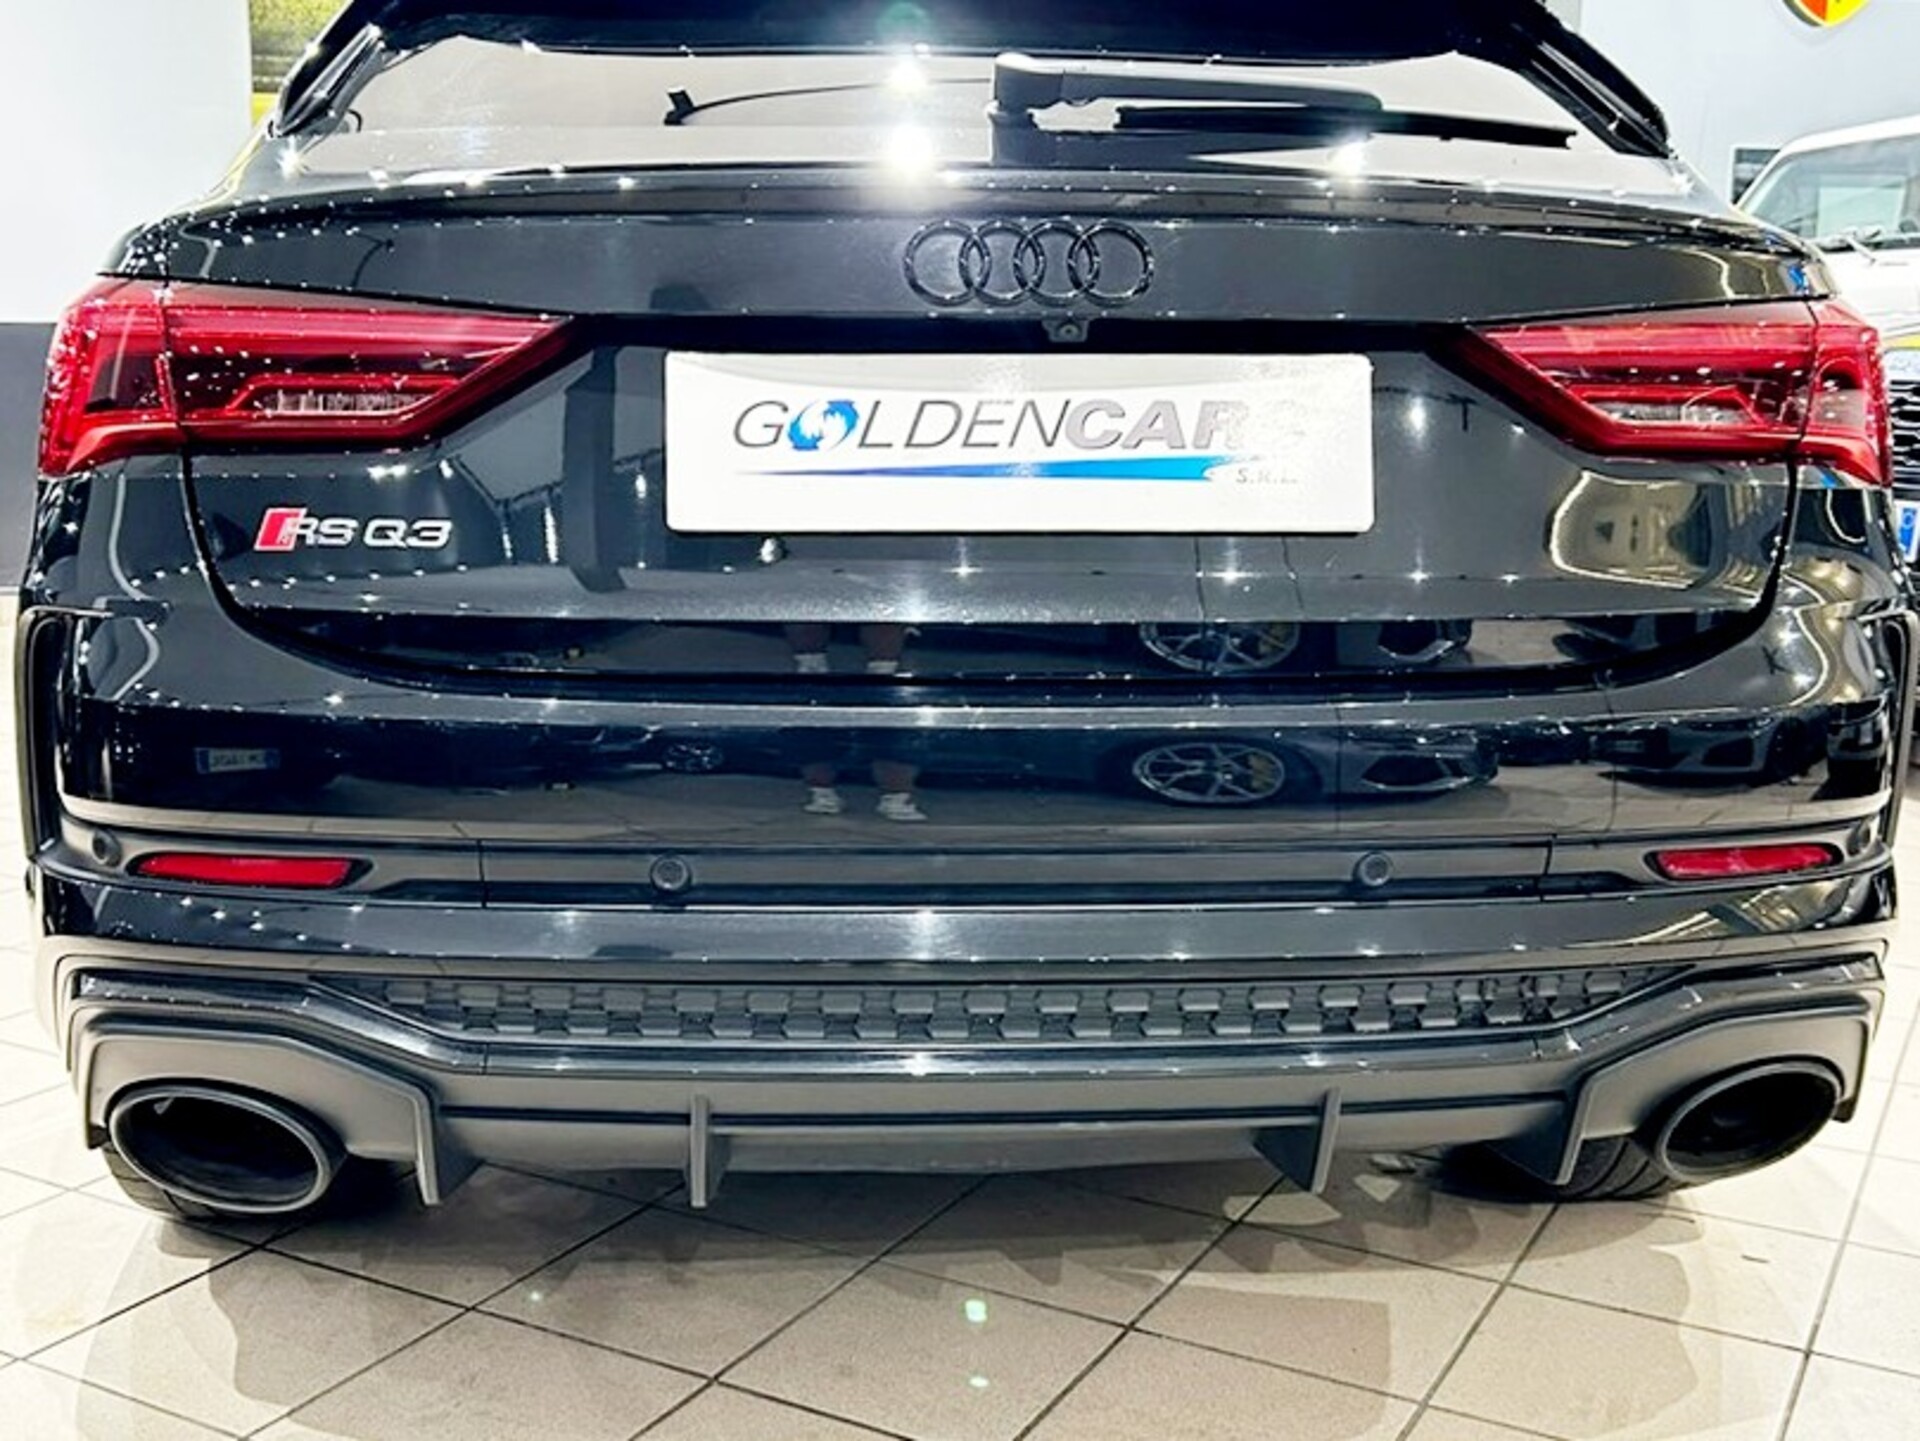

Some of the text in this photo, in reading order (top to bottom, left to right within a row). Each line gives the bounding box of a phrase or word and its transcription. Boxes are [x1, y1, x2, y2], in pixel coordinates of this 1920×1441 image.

[733, 398, 1303, 452] GOLDENCAR
[271, 512, 453, 548] RS Q3
